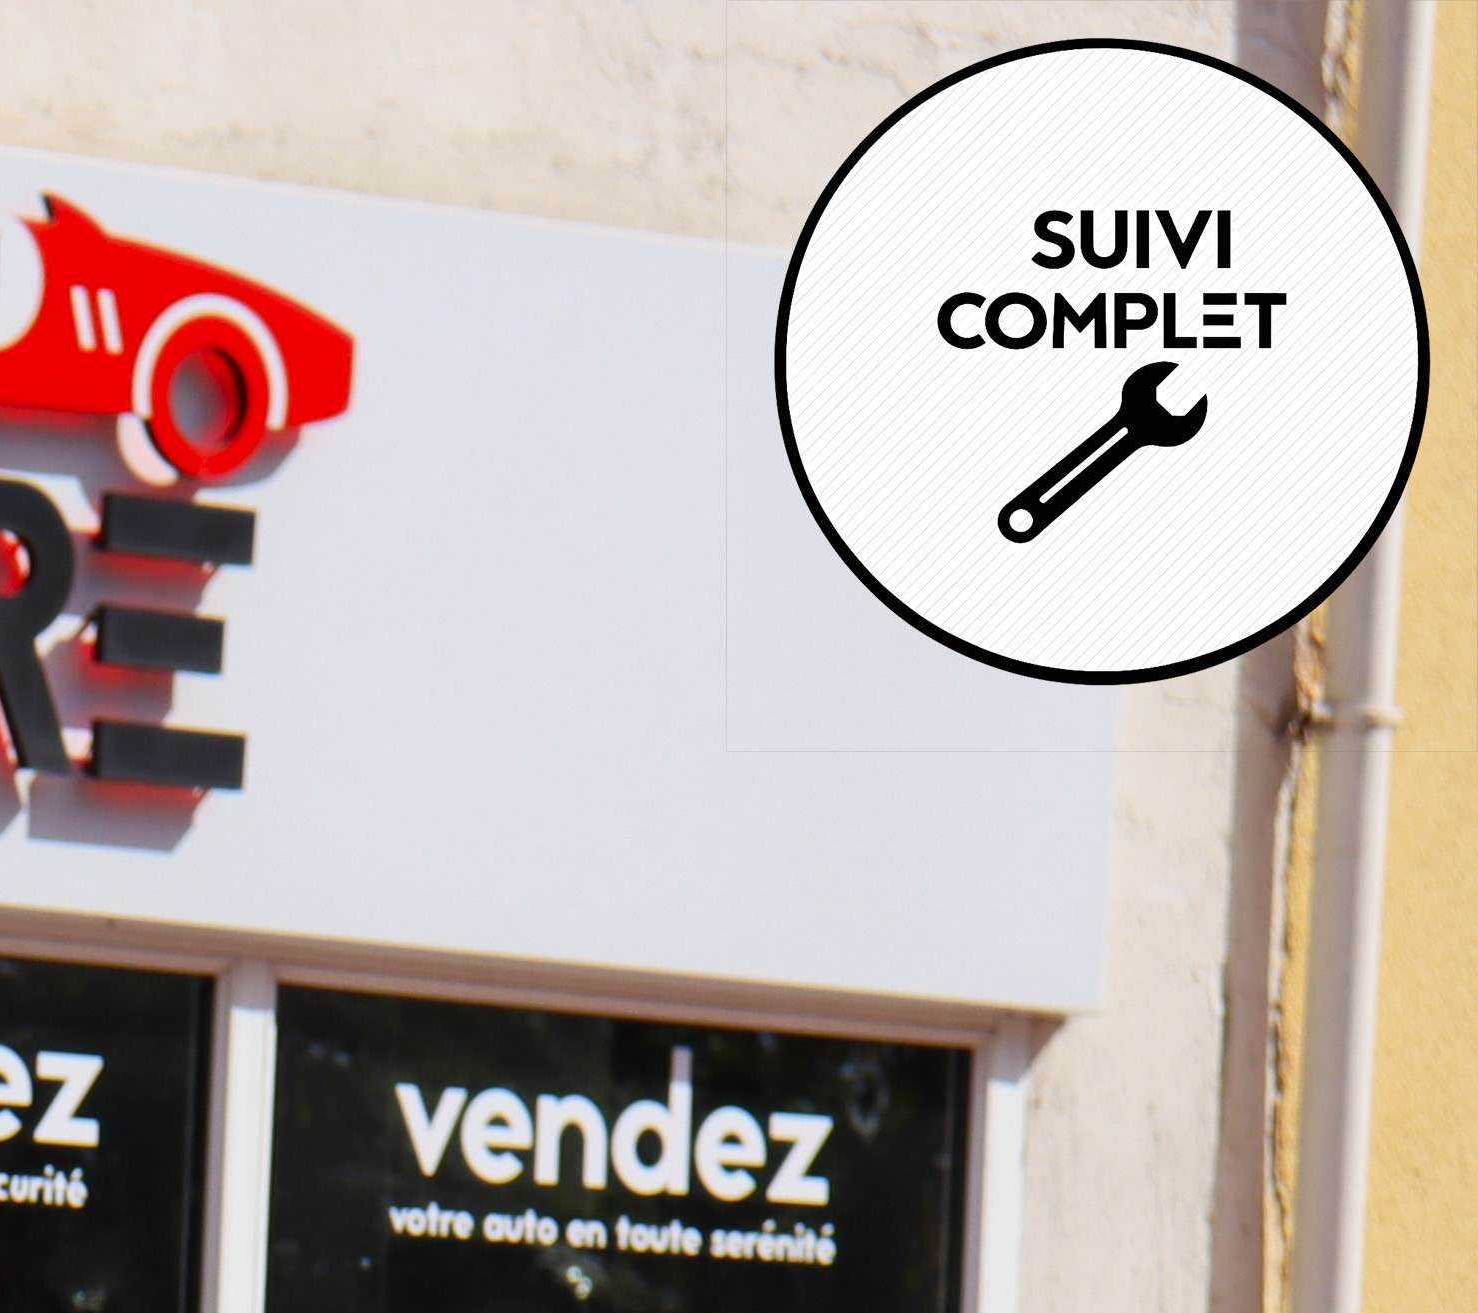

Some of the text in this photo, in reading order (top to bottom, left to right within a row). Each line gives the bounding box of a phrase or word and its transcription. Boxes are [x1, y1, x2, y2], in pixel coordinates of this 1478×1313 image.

[394, 1046, 834, 1206] vendez
[388, 1201, 473, 1240] votre
[483, 1209, 559, 1246] auto
[567, 1219, 607, 1249] en
[616, 1215, 703, 1256] toute
